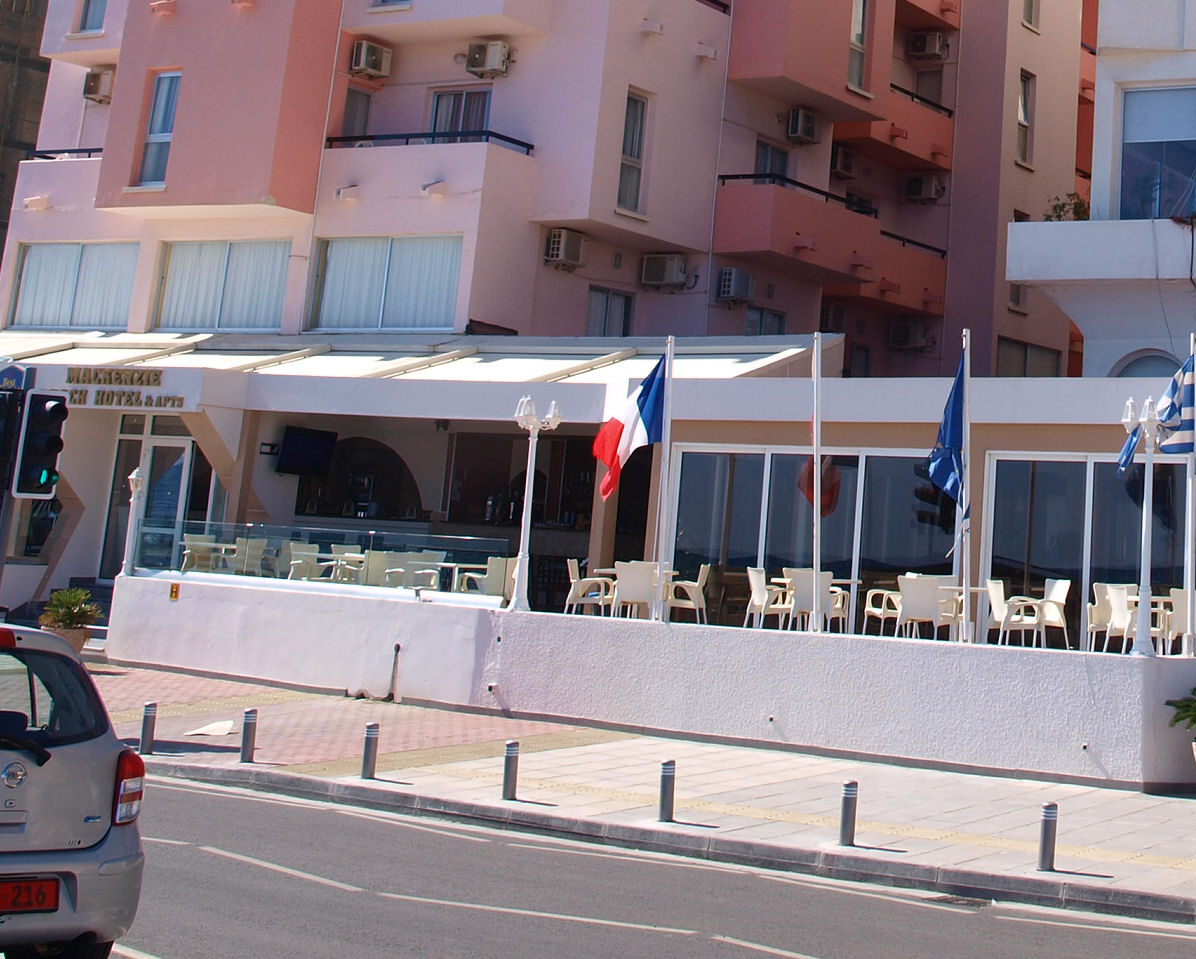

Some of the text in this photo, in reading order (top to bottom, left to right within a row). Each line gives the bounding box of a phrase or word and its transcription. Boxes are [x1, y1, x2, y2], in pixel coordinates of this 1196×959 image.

[66, 367, 163, 386] MACKENZIE
[94, 390, 142, 407] HOTEL
[11, 884, 47, 907] 216
